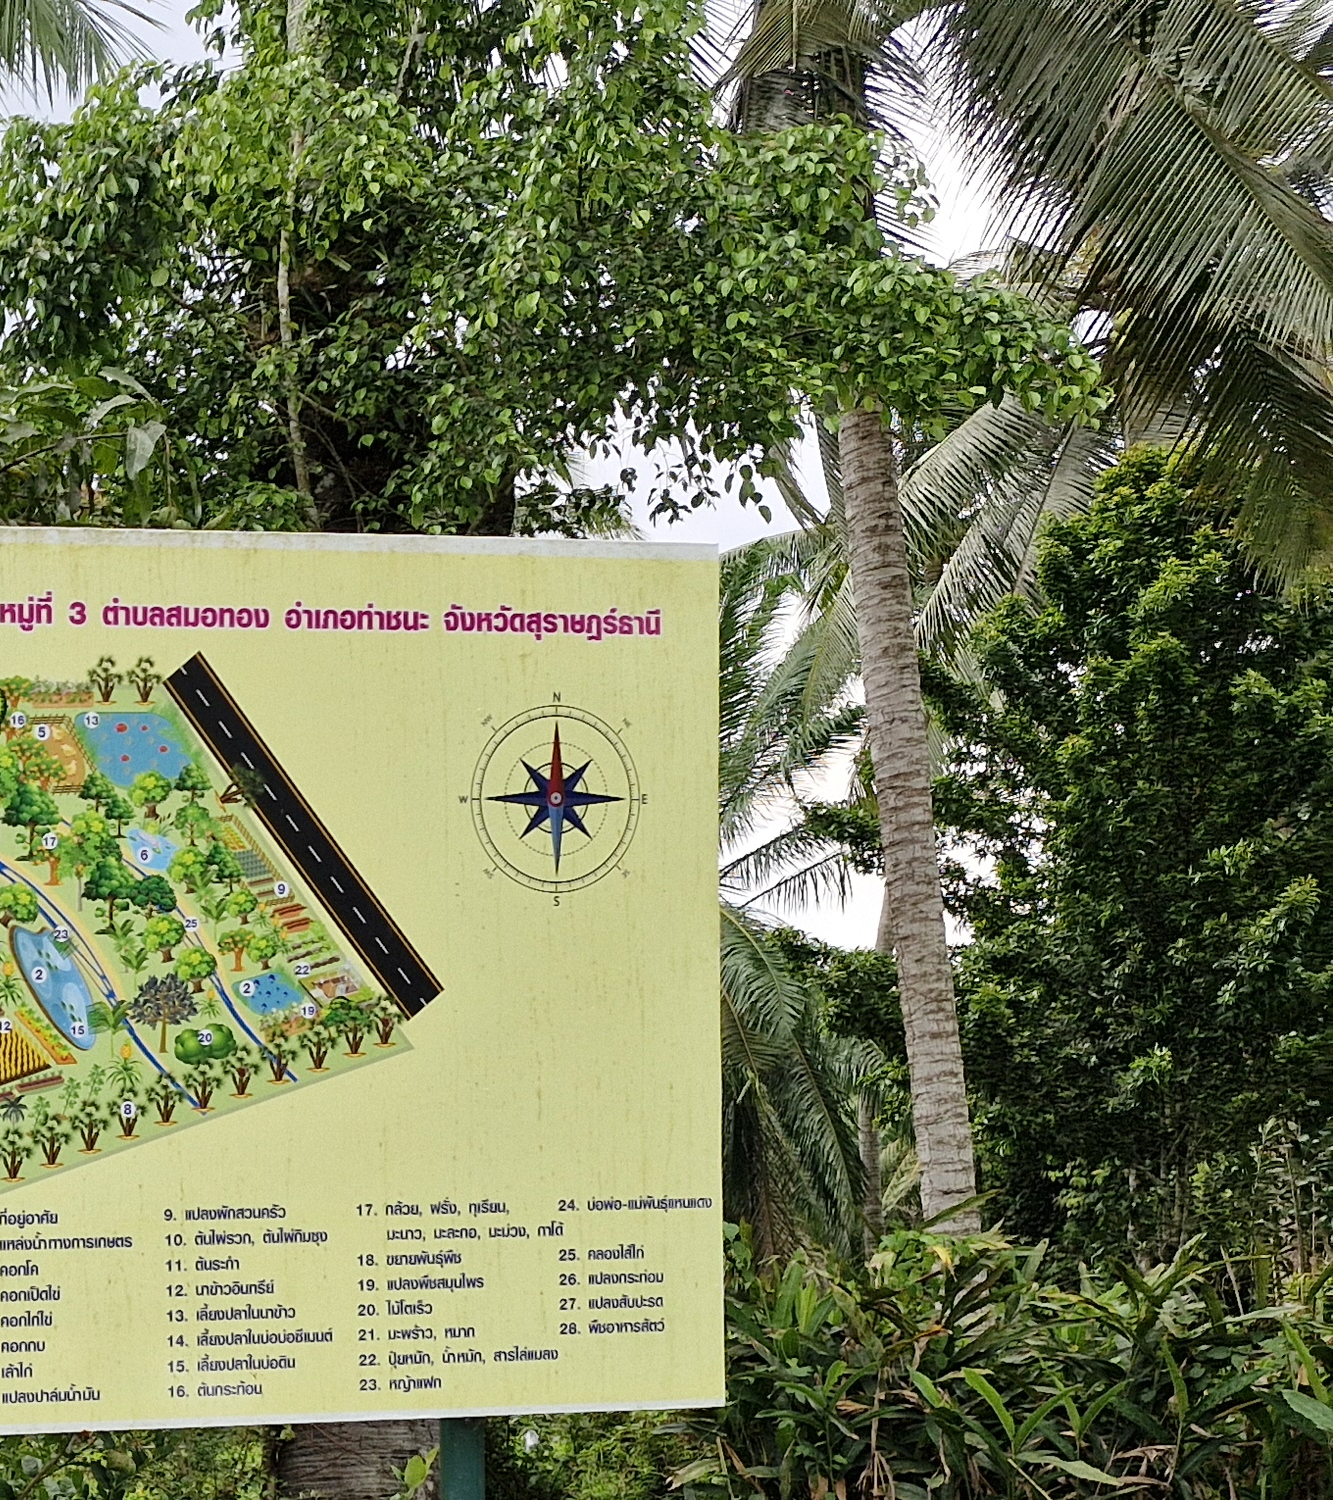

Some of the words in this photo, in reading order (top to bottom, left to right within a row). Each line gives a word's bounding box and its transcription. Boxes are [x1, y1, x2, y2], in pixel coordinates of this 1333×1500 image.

[68, 601, 87, 625] 3
[102, 597, 270, 628] ตำบลสมอทอง
[284, 600, 429, 631] อำเภอท่าชนะ
[552, 691, 562, 703] N
[85, 715, 99, 726] 13
[458, 795, 469, 804] W
[641, 793, 648, 805] E
[553, 895, 560, 907] S
[163, 1207, 177, 1222] 9.
[184, 1203, 287, 1221] แปลงผักสวนครัว
[355, 1202, 378, 1217] 17.
[384, 1200, 423, 1217] กล้วย,
[429, 1196, 461, 1216] ฝรั่ง,
[468, 1198, 510, 1218] ทุเรียน,
[557, 1198, 580, 1212] 24.
[164, 1233, 187, 1247] 10.
[193, 1228, 255, 1246] ต้นไผ่รวก,
[386, 1228, 426, 1242] มะนาว,
[433, 1227, 481, 1240] มะละกอ,
[488, 1223, 530, 1240] มะม่วง,
[356, 1253, 379, 1267] 18.
[385, 1249, 462, 1268] ขยายพันธุ์พืช
[558, 1247, 580, 1262] 25.
[587, 1243, 645, 1261] คลองไส้ไก่
[0, 1258, 39, 1277] คอกโค
[165, 1258, 188, 1272] 11.
[194, 1255, 240, 1271] ต้นระกำ
[165, 1284, 188, 1297] 12.
[195, 1278, 275, 1296] นาข้าวอินทรีย์
[357, 1278, 379, 1292] 19.
[386, 1271, 485, 1293] แปลงพืชสมุนไพร
[558, 1272, 581, 1286] 26.
[587, 1271, 664, 1285] แปลงกระท่อม
[0, 1283, 61, 1303] คอกเป็ดไข่
[558, 1297, 581, 1311] 27.
[588, 1293, 664, 1310] แปลงสับปะรด
[165, 1308, 188, 1323] 13.
[196, 1302, 296, 1322] เลี้ยงปลาในนาข้าว
[356, 1303, 379, 1317] 20.
[384, 1298, 433, 1316] ไม้โตเร็ว
[0, 1309, 53, 1328] คอกไก่ไข่
[559, 1321, 581, 1335] 28.
[587, 1317, 665, 1334] พืชอาหารสัตว์
[166, 1334, 189, 1348] 14.
[196, 1327, 333, 1347] เลี้ยงปลาในบ่อบ่อซีเมนต์
[357, 1327, 380, 1341] 21.
[387, 1324, 437, 1341] มะพร้าว,
[444, 1326, 475, 1339] หมาก
[0, 1340, 46, 1353] คอกกบ
[167, 1359, 189, 1373] 15.
[196, 1353, 296, 1372] เลี้ยงปลาในบ่อดิน
[358, 1353, 381, 1367] 22.
[387, 1349, 434, 1369] ปุ๋ยหมัก,
[441, 1345, 486, 1365] น้ำหมัก,
[493, 1345, 559, 1362] สารไล่แมลง
[0, 1361, 33, 1379] เล้าไก่
[1, 1382, 101, 1404] แปลงปาล์มน้ำมัน
[167, 1384, 190, 1398] 16.
[197, 1379, 263, 1397] ต้นกระท้อน
[358, 1378, 381, 1391] 23.
[388, 1374, 442, 1393] หญ้าแฝก
